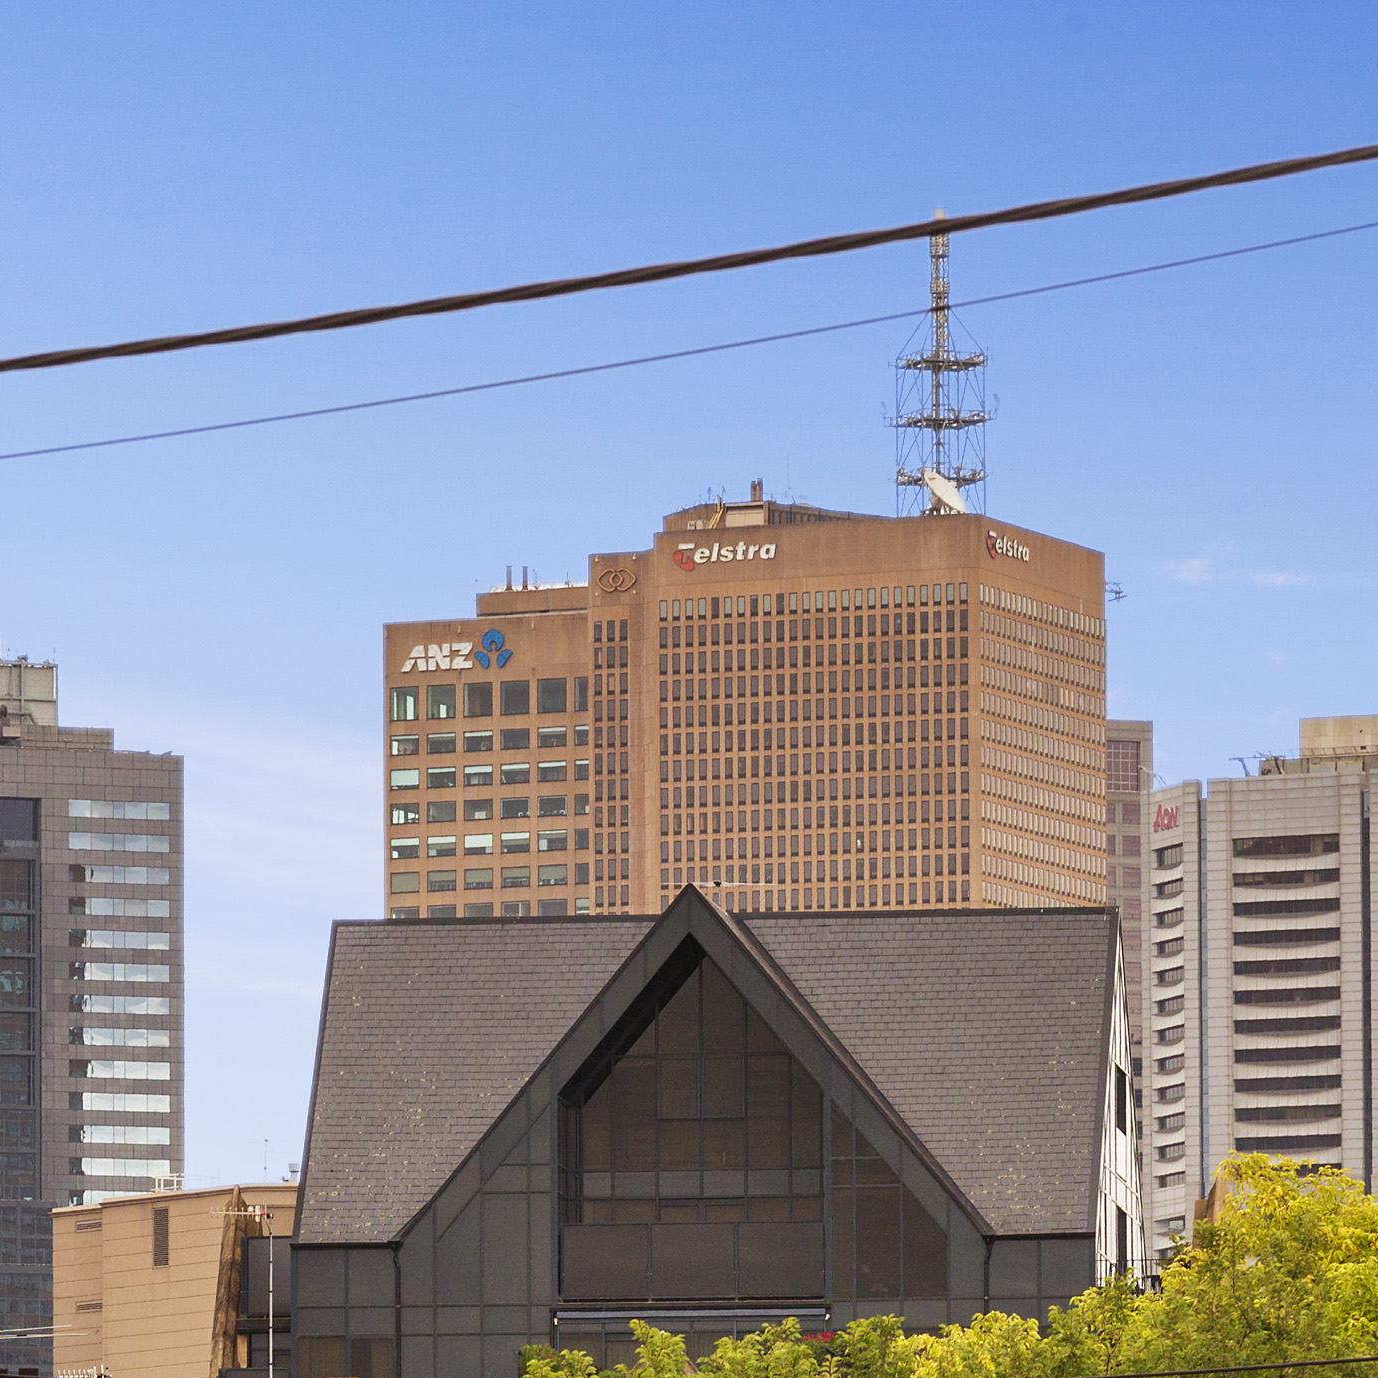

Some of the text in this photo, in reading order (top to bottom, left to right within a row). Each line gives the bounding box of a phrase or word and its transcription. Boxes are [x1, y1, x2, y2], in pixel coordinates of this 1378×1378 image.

[673, 541, 777, 571] Telstra
[986, 530, 1030, 562] Telstra
[401, 642, 473, 673] ANZ
